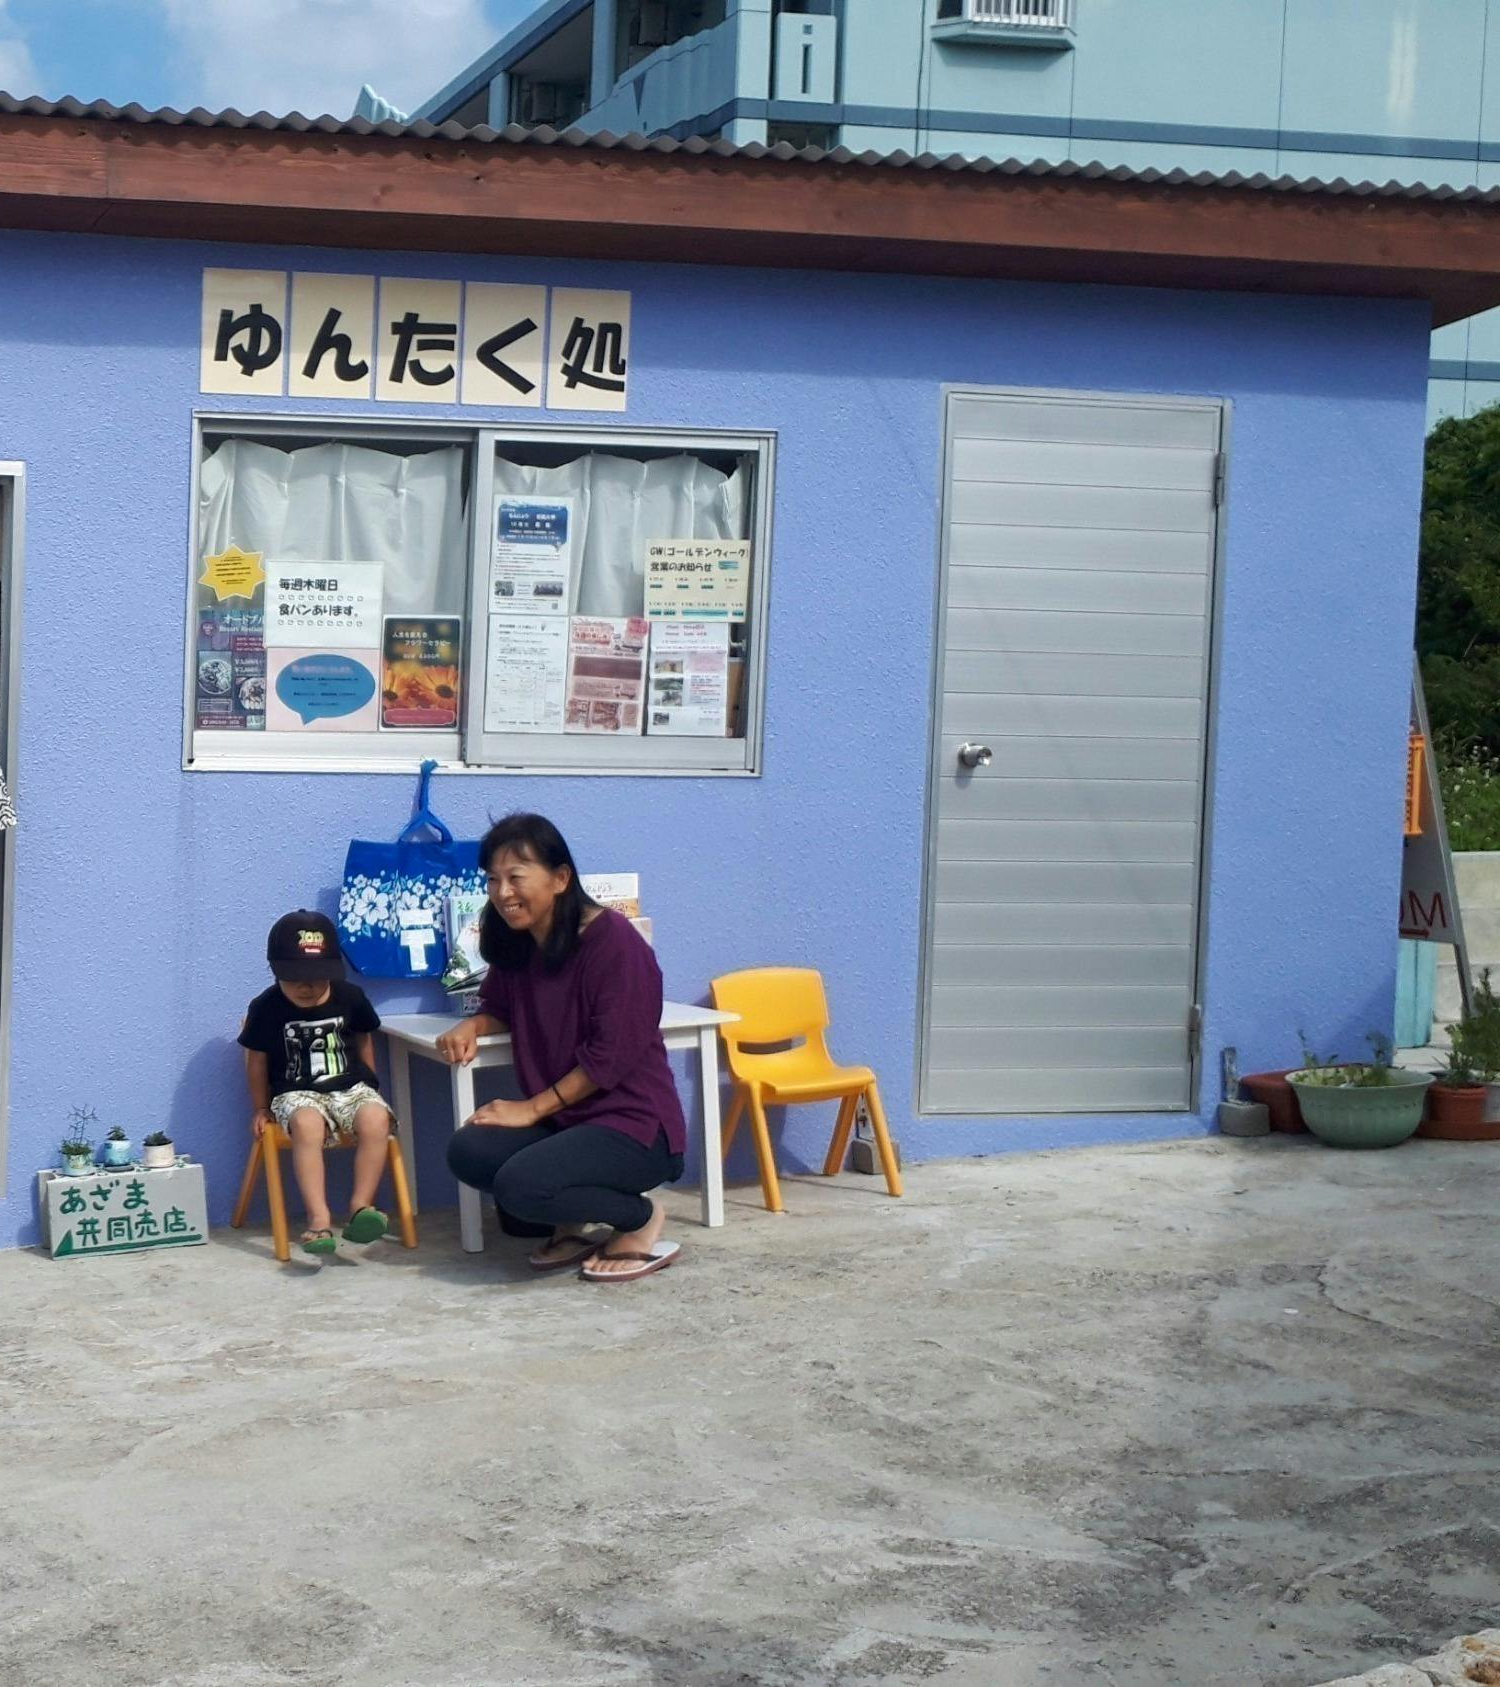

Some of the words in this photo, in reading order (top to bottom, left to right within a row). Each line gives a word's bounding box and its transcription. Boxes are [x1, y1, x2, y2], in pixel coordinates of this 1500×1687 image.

[213, 303, 626, 396] ゆんたく処
[650, 562, 712, 572] 営業のお知らせ
[279, 578, 338, 591] 毎週木曜日
[59, 1178, 150, 1215] あざま
